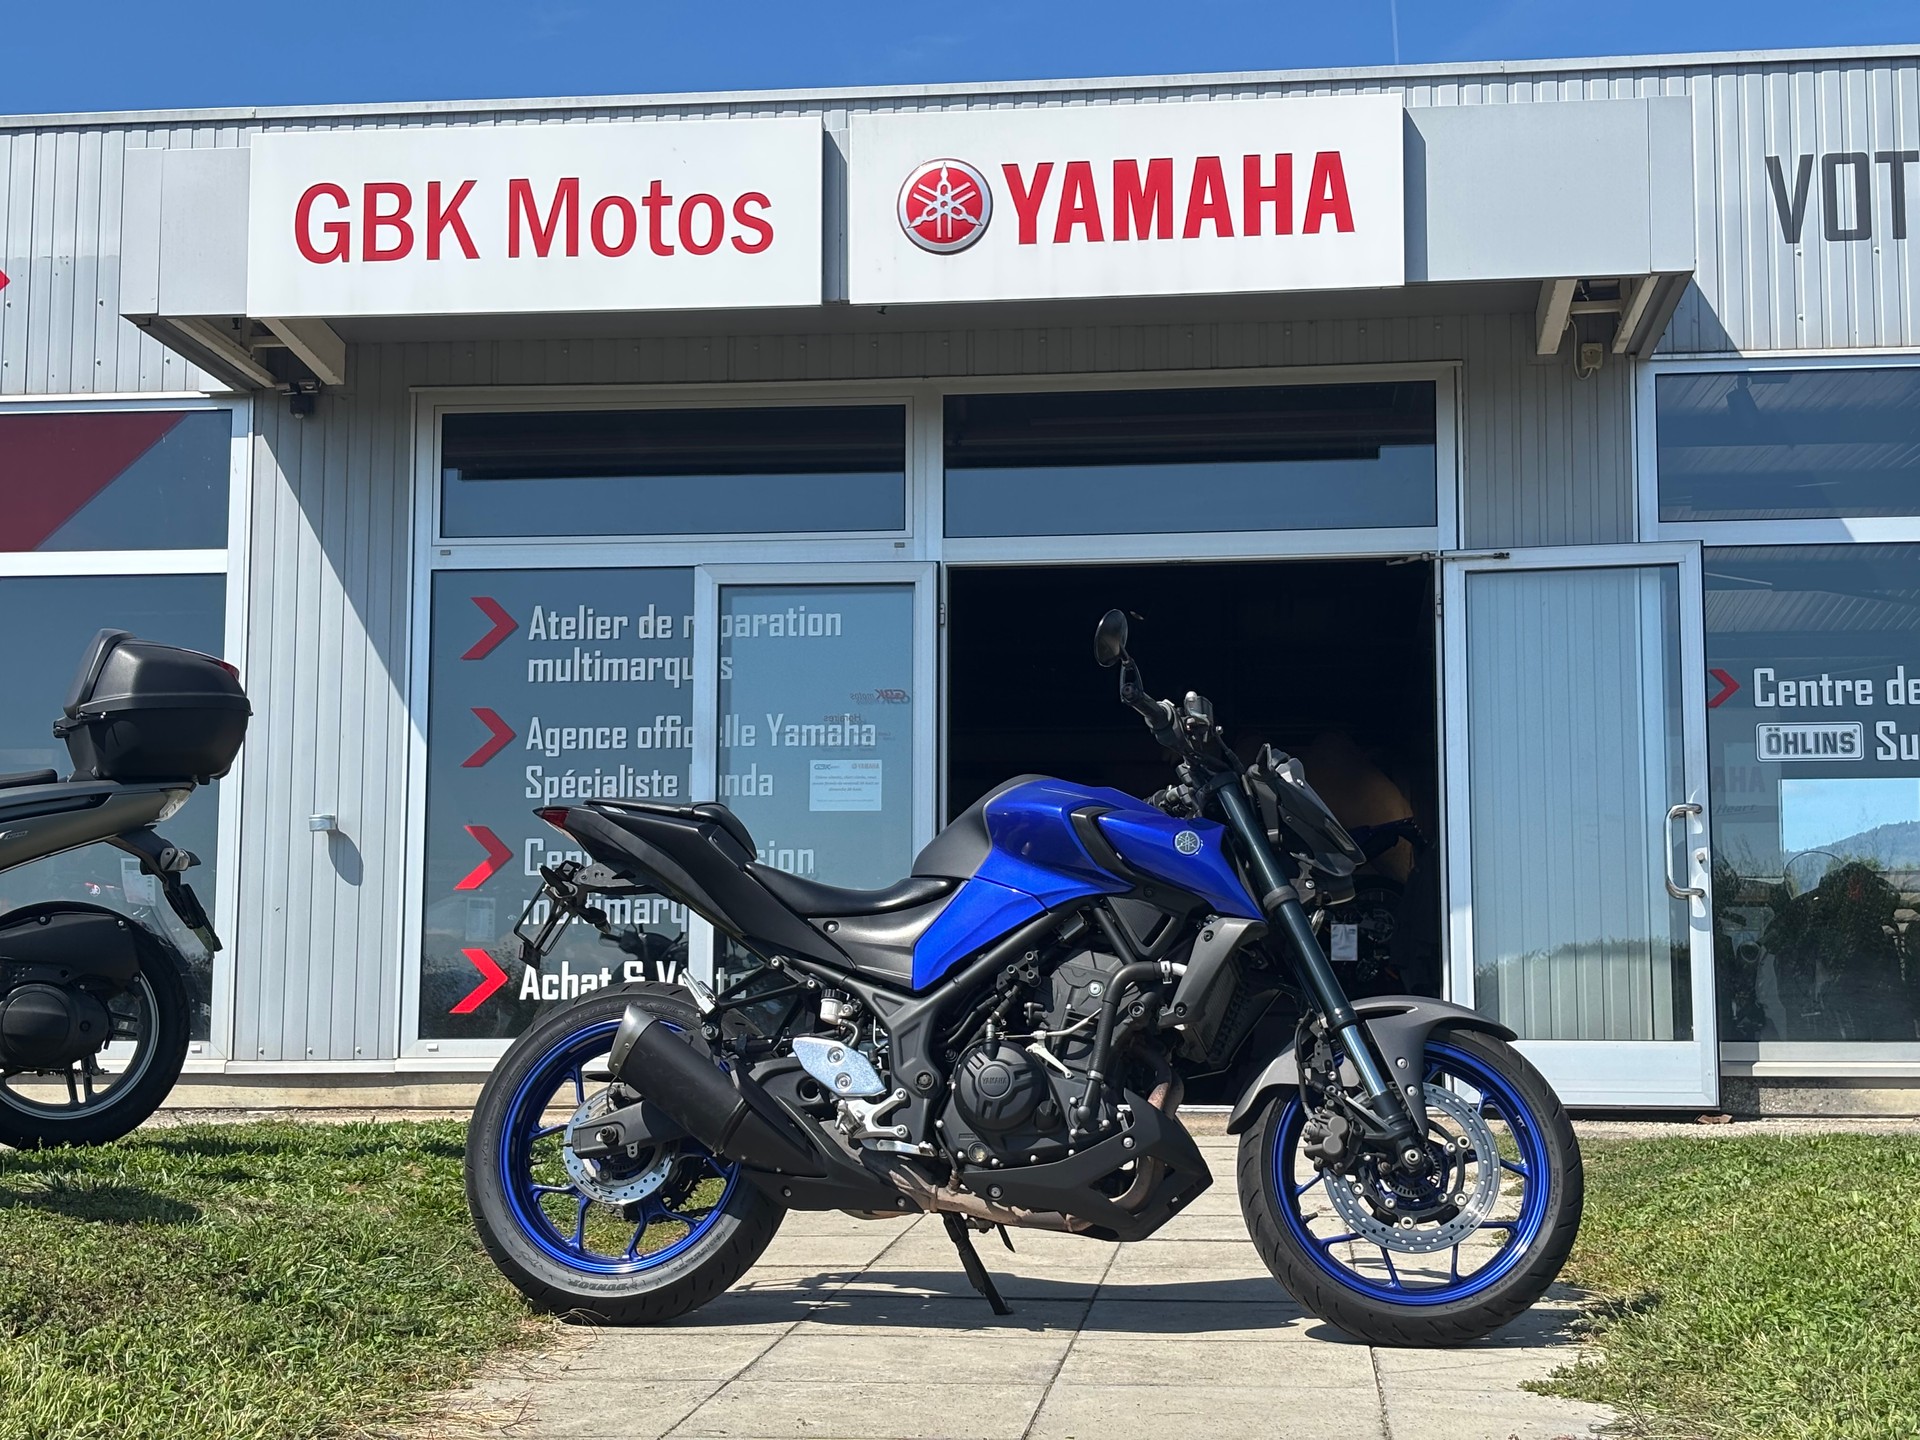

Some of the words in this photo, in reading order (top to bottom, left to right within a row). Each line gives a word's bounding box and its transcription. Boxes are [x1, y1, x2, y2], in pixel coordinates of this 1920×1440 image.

[1001, 151, 1355, 245] YAMAHA
[1765, 150, 1919, 244] VOT
[294, 179, 480, 264] GBK
[508, 177, 775, 258] Motos
[528, 604, 629, 641] Atelier
[638, 603, 672, 640] de
[682, 605, 842, 646] rparation
[527, 647, 733, 689] multimarqus
[1753, 667, 1874, 708] Centre
[1886, 665, 1920, 706] de
[525, 716, 627, 758] Agence
[766, 713, 876, 747] Yamaha
[1766, 727, 1856, 755] ÖHLINS
[1875, 720, 1920, 761] Su
[525, 764, 679, 806] Spécialiste
[519, 960, 612, 1000] Achat
[982, 1077, 1007, 1085] YAMAHA
